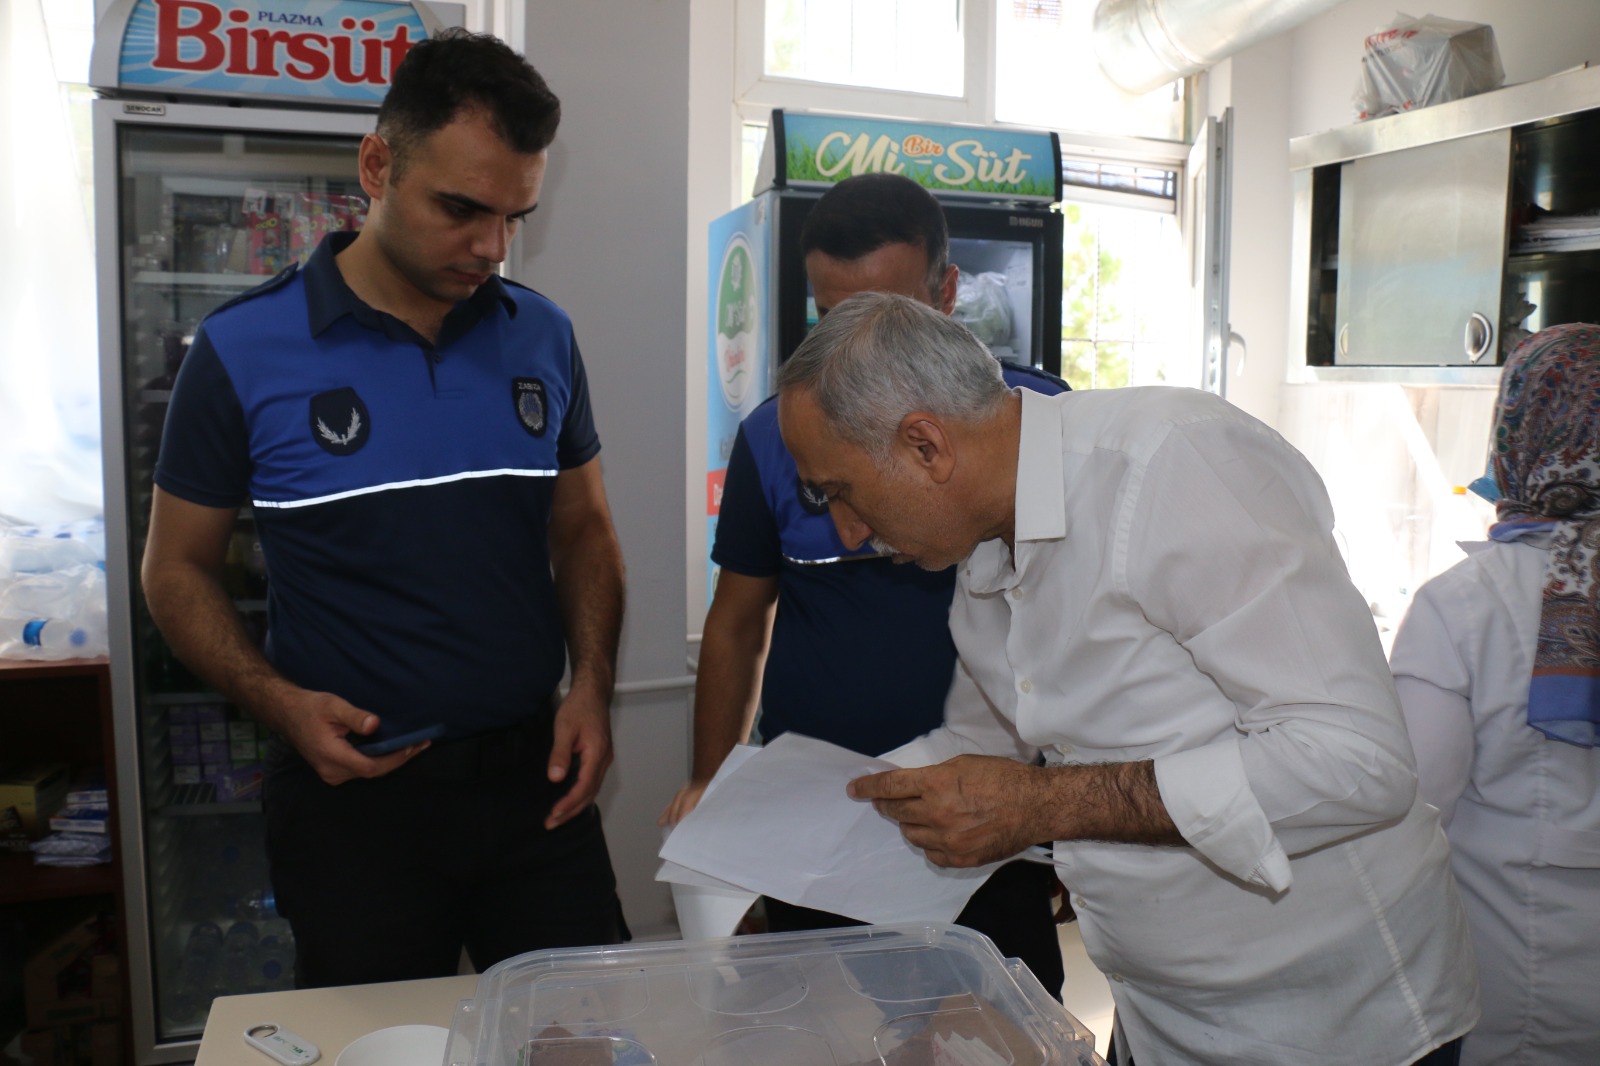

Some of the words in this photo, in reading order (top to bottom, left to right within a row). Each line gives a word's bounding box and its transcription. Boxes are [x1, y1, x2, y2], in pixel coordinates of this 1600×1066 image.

[257, 10, 323, 27] PLAZMA
[152, 0, 415, 85] Birsüt
[903, 135, 943, 156] Bir
